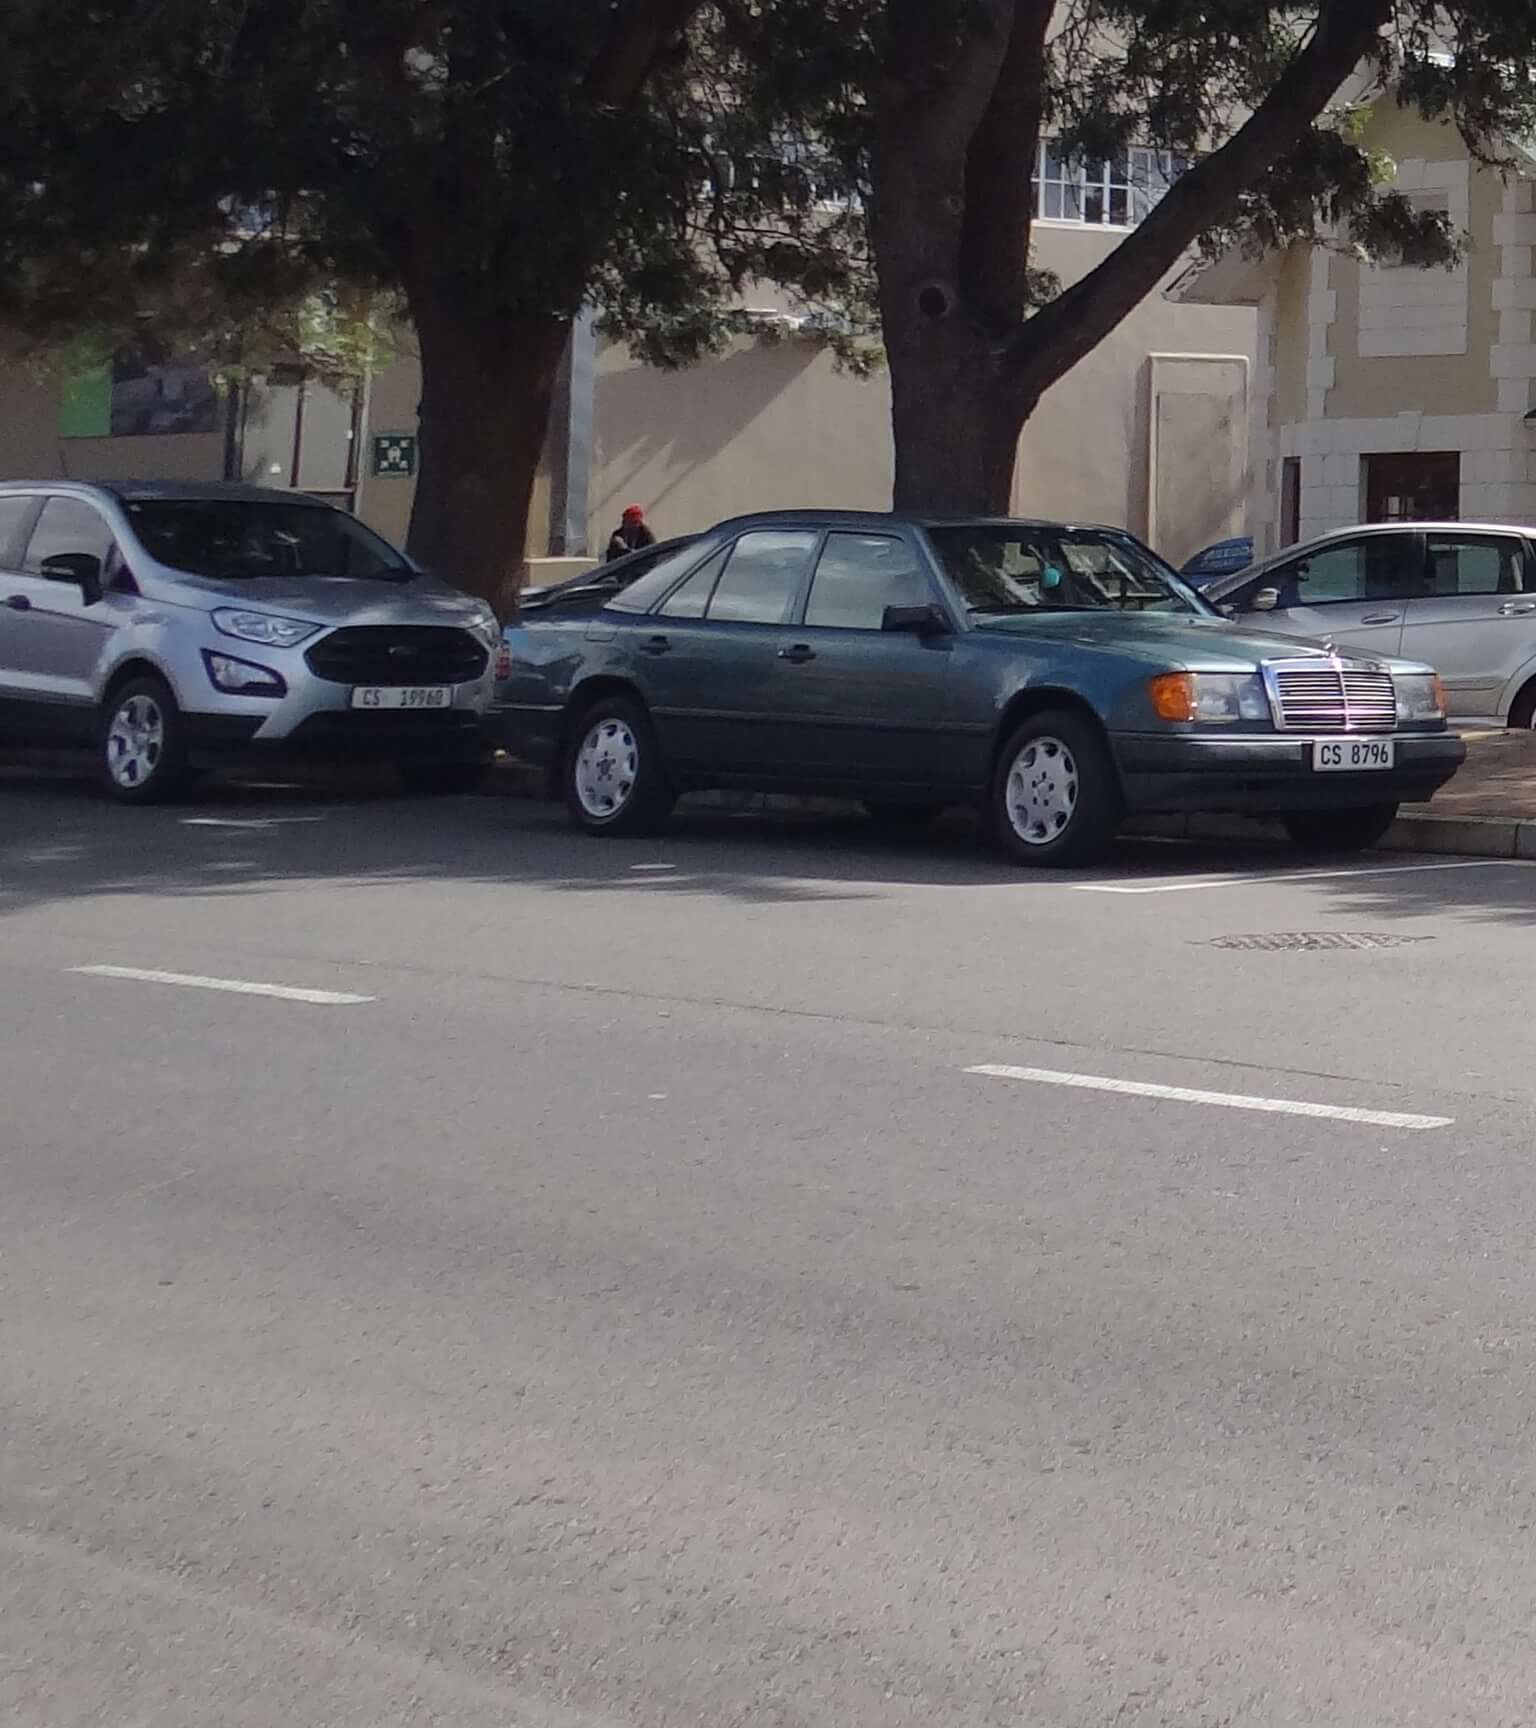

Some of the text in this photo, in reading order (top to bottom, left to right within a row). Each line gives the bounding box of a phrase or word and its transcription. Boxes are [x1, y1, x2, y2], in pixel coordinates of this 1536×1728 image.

[363, 689, 381, 706] CS
[1321, 744, 1389, 765] CS 8796
